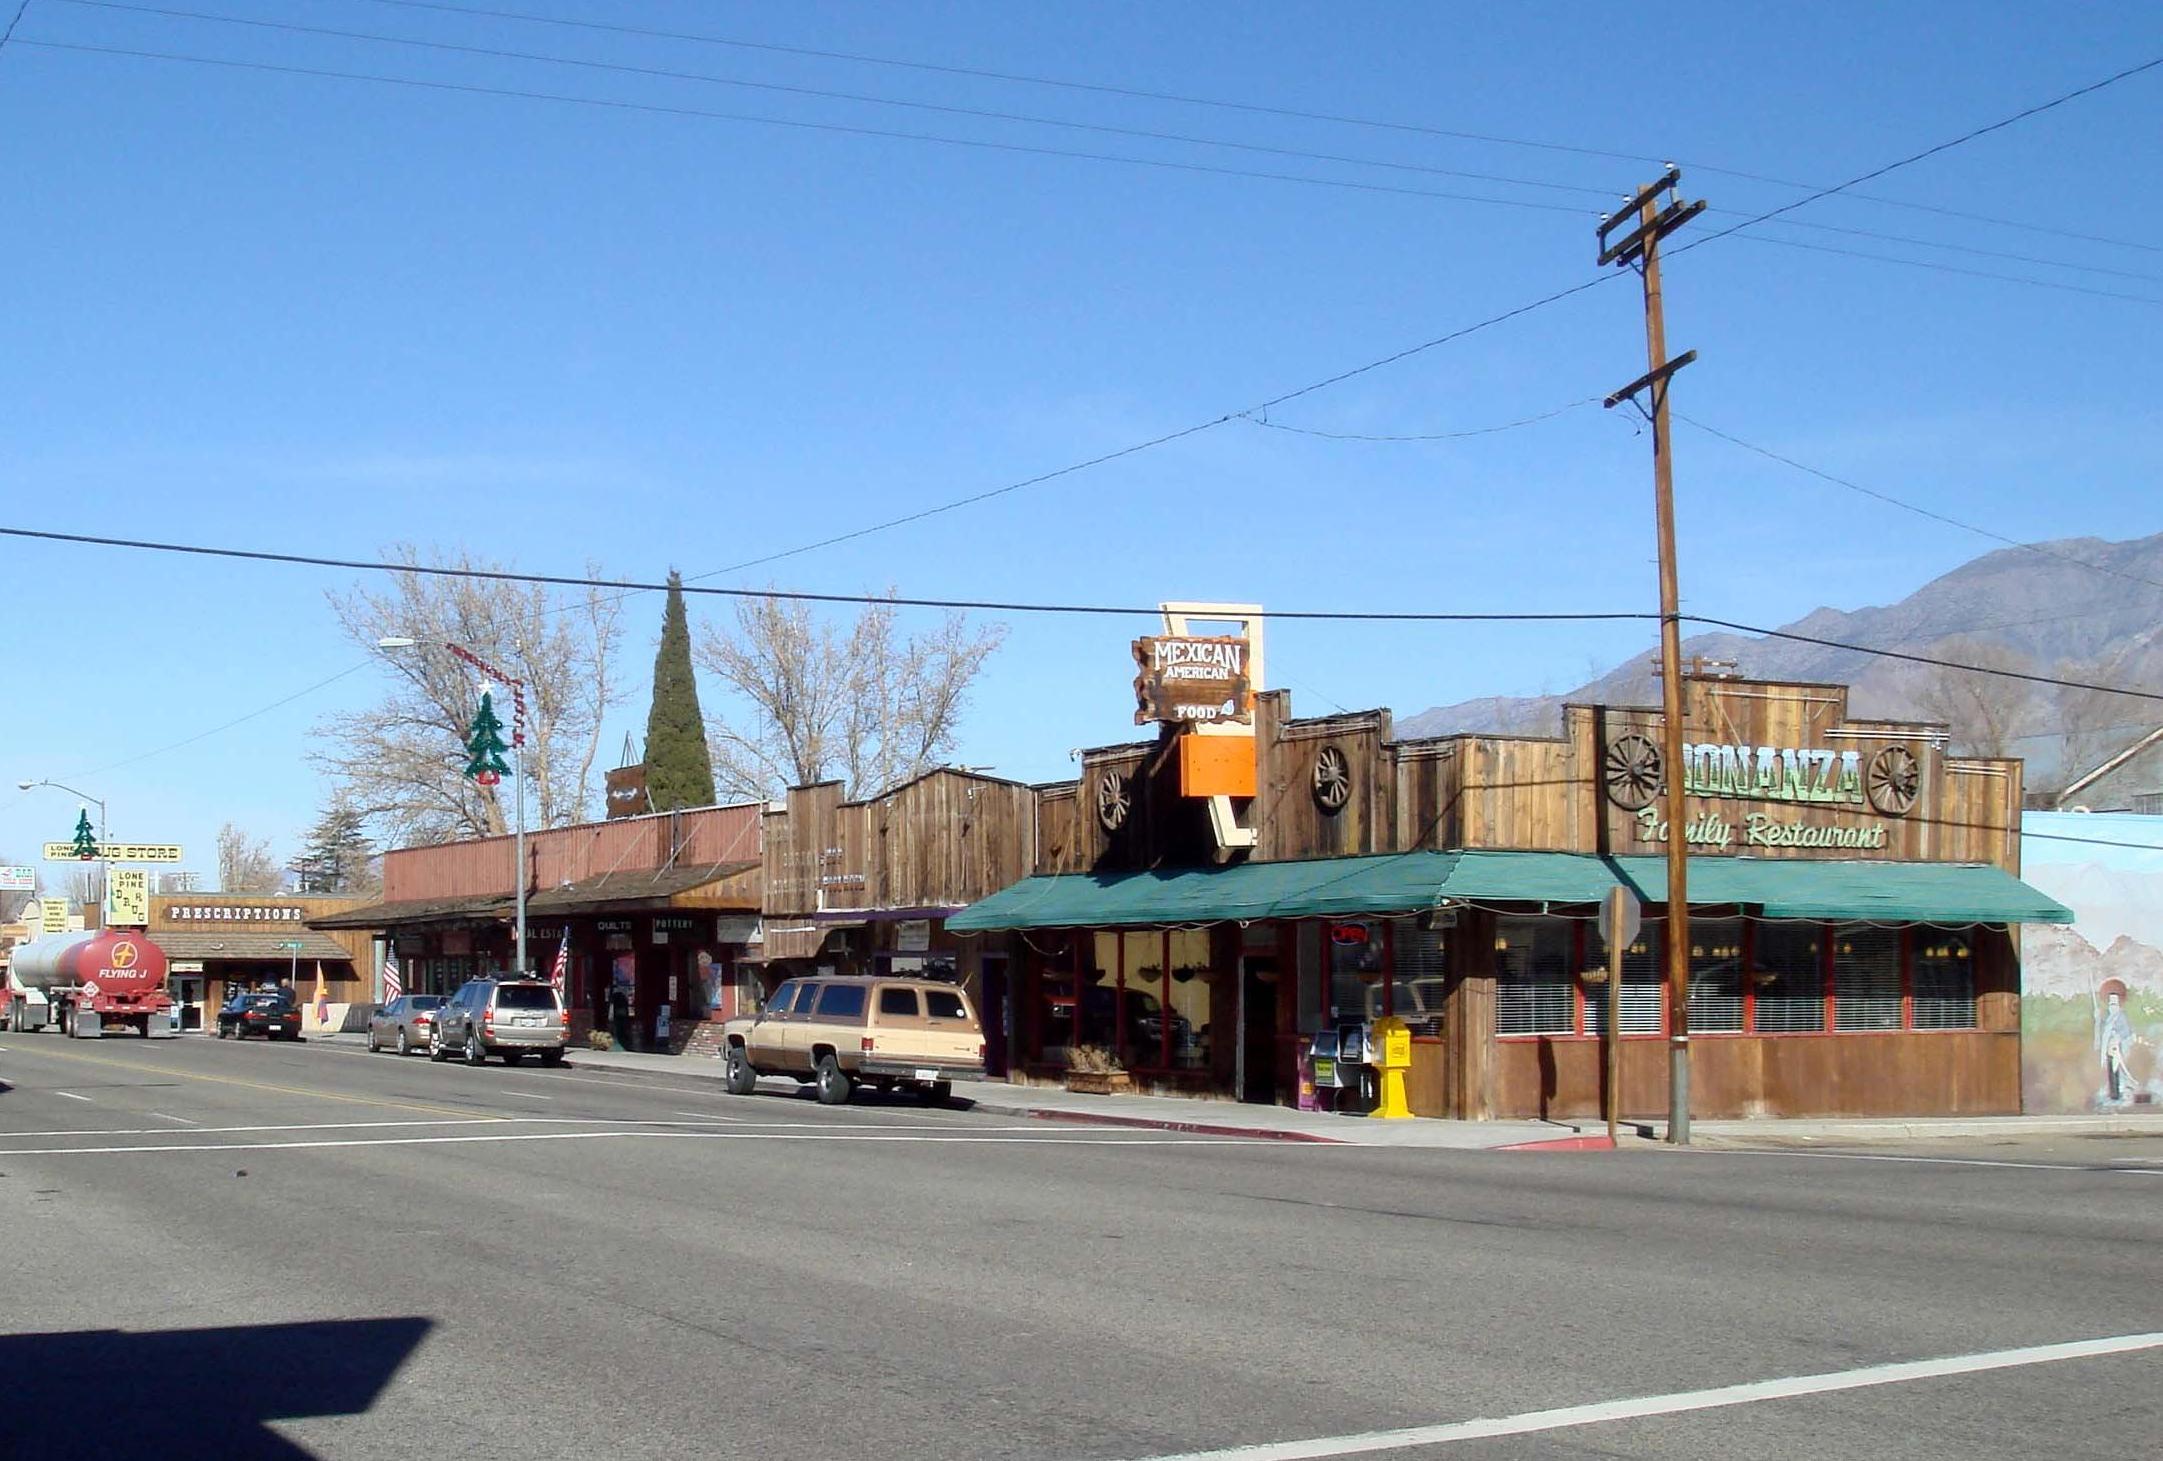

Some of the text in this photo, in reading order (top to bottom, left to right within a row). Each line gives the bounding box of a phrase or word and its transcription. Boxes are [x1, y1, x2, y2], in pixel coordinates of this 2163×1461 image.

[1154, 641, 1241, 675] MEXICAN
[1163, 666, 1230, 680] AMERICAN
[1177, 705, 1217, 719] FOOD
[1746, 812, 1885, 848] Restaurant
[127, 847, 178, 858] STORE
[119, 872, 144, 880] LONE
[171, 906, 301, 920] PRESCRIPTIONS
[598, 921, 632, 931] QUILTS
[99, 969, 148, 979] FLYING J
